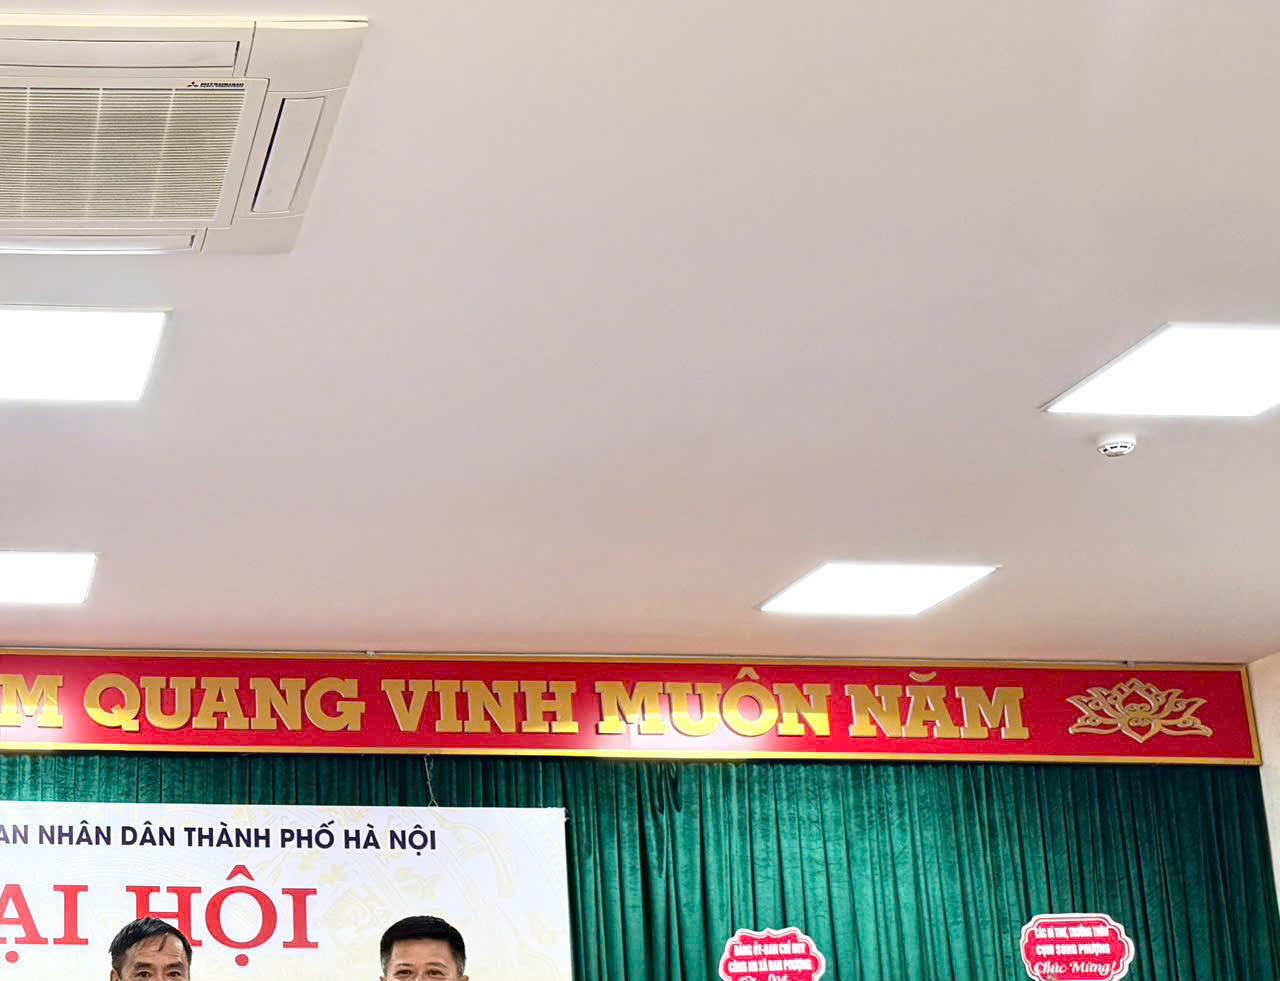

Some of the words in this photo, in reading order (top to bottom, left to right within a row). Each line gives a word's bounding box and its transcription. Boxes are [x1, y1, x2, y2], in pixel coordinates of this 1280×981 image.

[84, 673, 365, 732] QUANG
[381, 679, 579, 733] VINH
[594, 667, 831, 737] MUÔN
[844, 671, 1030, 739] NĂM
[38, 819, 111, 845] NHÂN
[121, 820, 175, 846] DÂN
[184, 821, 270, 847] THÀNH
[280, 820, 335, 849] PHỐ
[344, 823, 381, 849] HÀ
[390, 824, 436, 856] NỘI
[125, 864, 319, 967] HỘI
[1034, 961, 1068, 974] Chúc
[1036, 944, 1055, 957] CỤM
[1056, 944, 1077, 955] SONG
[1078, 943, 1111, 956] PHƯỢNG
